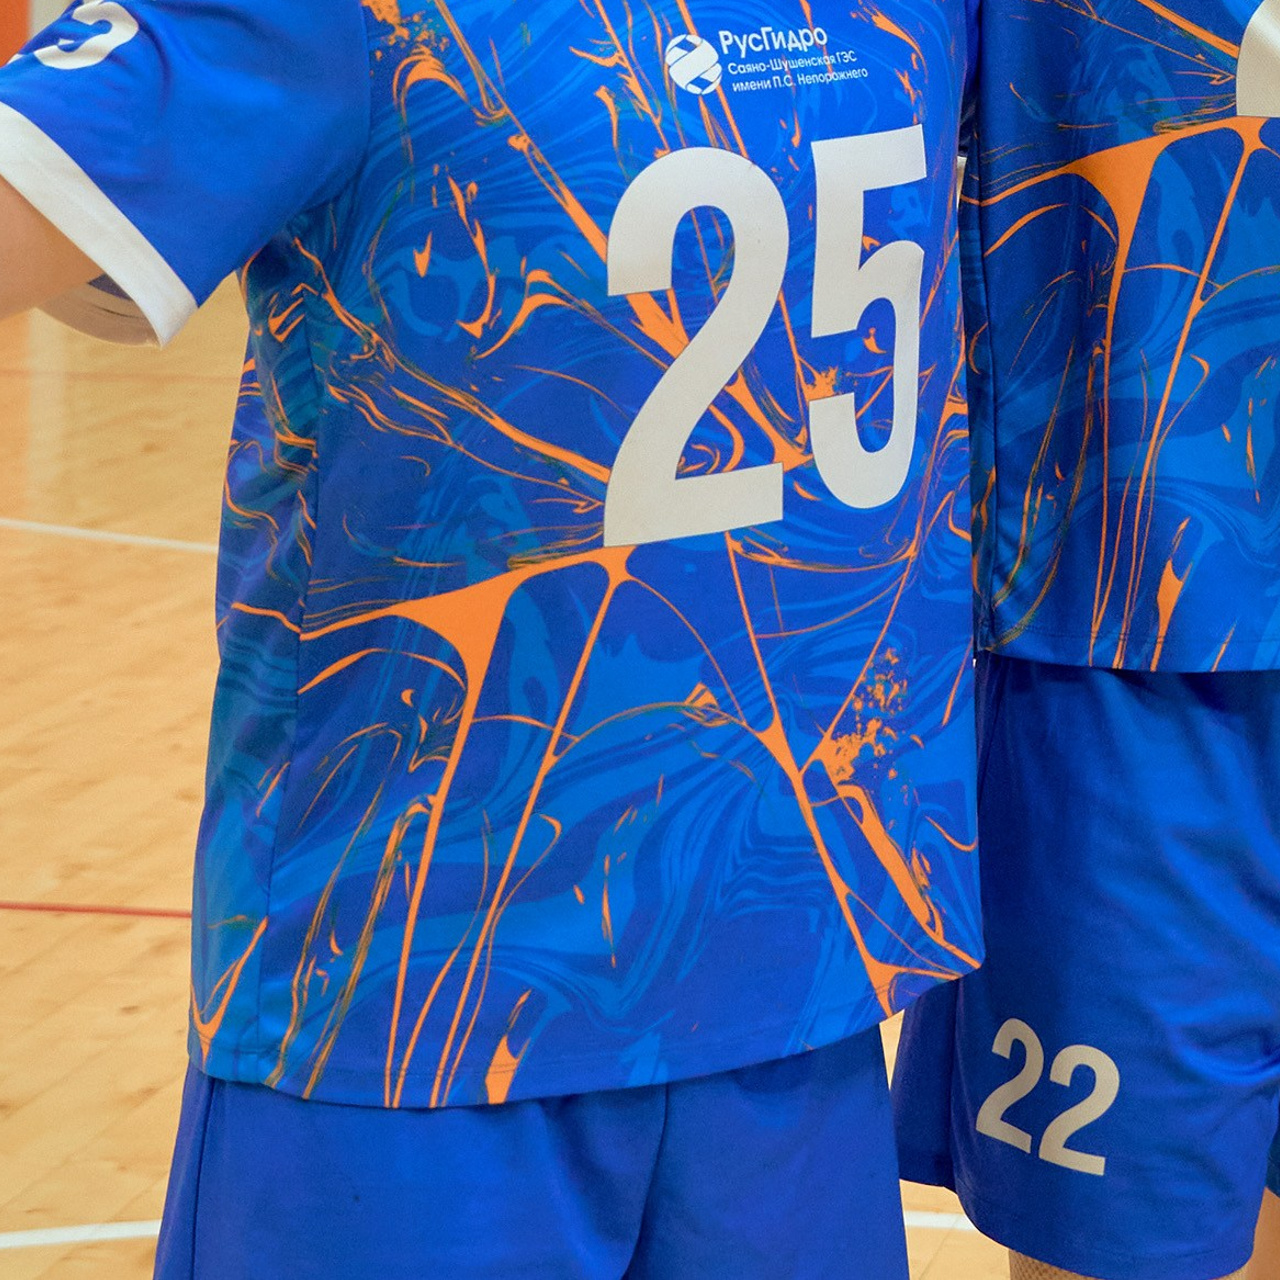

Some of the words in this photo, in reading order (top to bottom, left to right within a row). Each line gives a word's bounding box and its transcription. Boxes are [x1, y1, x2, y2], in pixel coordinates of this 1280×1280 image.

[718, 26, 828, 58] РусГидро
[727, 54, 836, 75] Саяно-Шушенская
[836, 50, 858, 63] ГЭС
[732, 77, 772, 93] имени
[773, 74, 796, 88] П.С.
[797, 67, 868, 86] Непорожнего
[604, 124, 928, 548] 25
[976, 1018, 1120, 1176] 22
